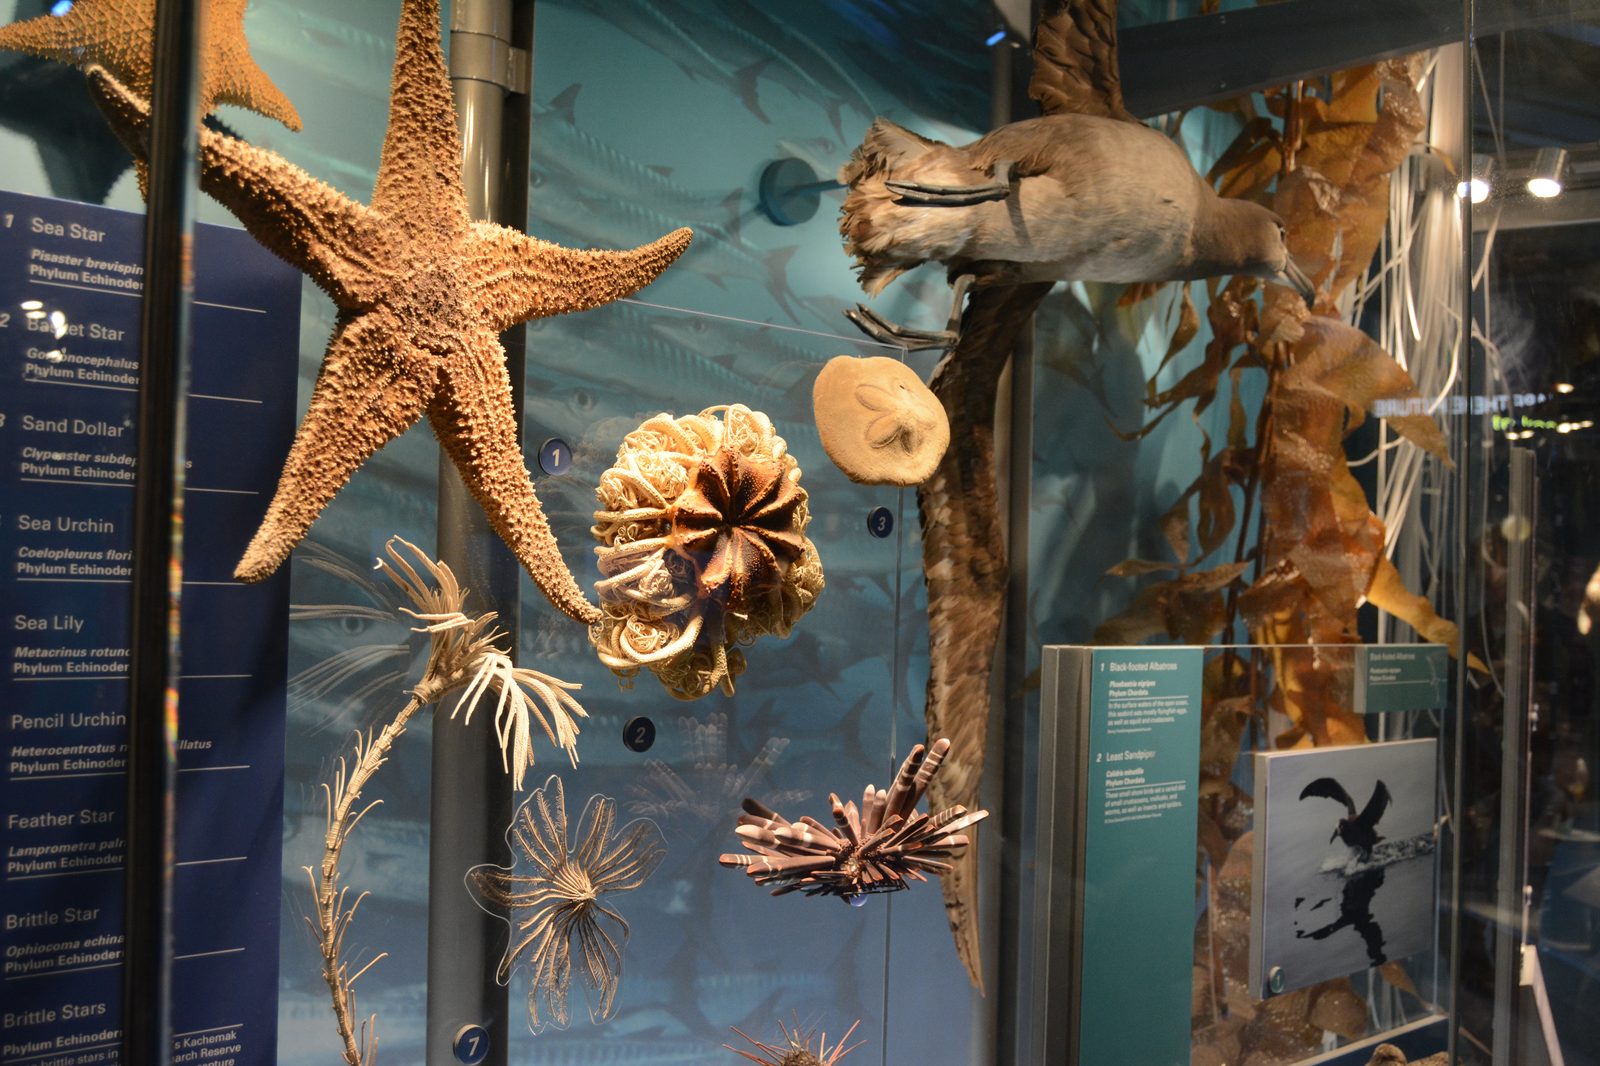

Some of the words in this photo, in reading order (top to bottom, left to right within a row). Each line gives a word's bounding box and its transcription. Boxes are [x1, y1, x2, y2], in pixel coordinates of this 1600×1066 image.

[5, 214, 14, 228] 1
[31, 217, 64, 236] Sea
[70, 223, 106, 243] Star
[31, 249, 83, 267] Pisaster
[29, 264, 79, 282] Phylum
[0, 313, 10, 328] 2
[27, 318, 85, 337] Baet
[89, 323, 125, 341] Star
[25, 363, 74, 379] Phylum
[22, 415, 68, 433] Sand
[73, 419, 125, 437] Dollar
[22, 446, 91, 462] Clypeaster
[552, 448, 560, 467] 1
[21, 462, 70, 477] Phylum
[18, 515, 51, 531] Sea
[57, 517, 114, 534] Urchin
[877, 516, 886, 531] 3
[18, 546, 103, 561] Coelopleurus
[17, 562, 67, 577] Phylum
[15, 614, 48, 631] Sea
[53, 614, 84, 633] Lily
[14, 647, 87, 659] Metacrinus
[13, 662, 62, 676] Phylum
[1101, 662, 1105, 672] 1
[11, 714, 64, 729] Pencil
[70, 712, 127, 728] Urchin
[634, 726, 646, 744] 2
[11, 743, 116, 758] Heterocentrotus
[1096, 752, 1102, 762] 2
[10, 761, 60, 775] Phylum
[8, 812, 75, 829] Feather
[80, 809, 115, 824] Star
[8, 840, 96, 858] Lamprometra
[7, 860, 57, 874] Phylum
[6, 913, 59, 930] Brittle
[64, 907, 100, 924] Star
[6, 939, 80, 957] Ophiocoma
[5, 958, 54, 974] Phylum
[58, 950, 125, 966] Echinoder
[4, 1009, 56, 1029] Brittle
[62, 1002, 107, 1020] Stars
[3, 1040, 52, 1056] Phylum
[56, 1029, 122, 1047] Echinoder
[184, 1030, 237, 1048] Kachemak
[469, 1035, 480, 1057] 7
[77, 1052, 105, 1064] stars
[107, 1048, 118, 1059] in
[200, 1044, 241, 1058] Reserve
